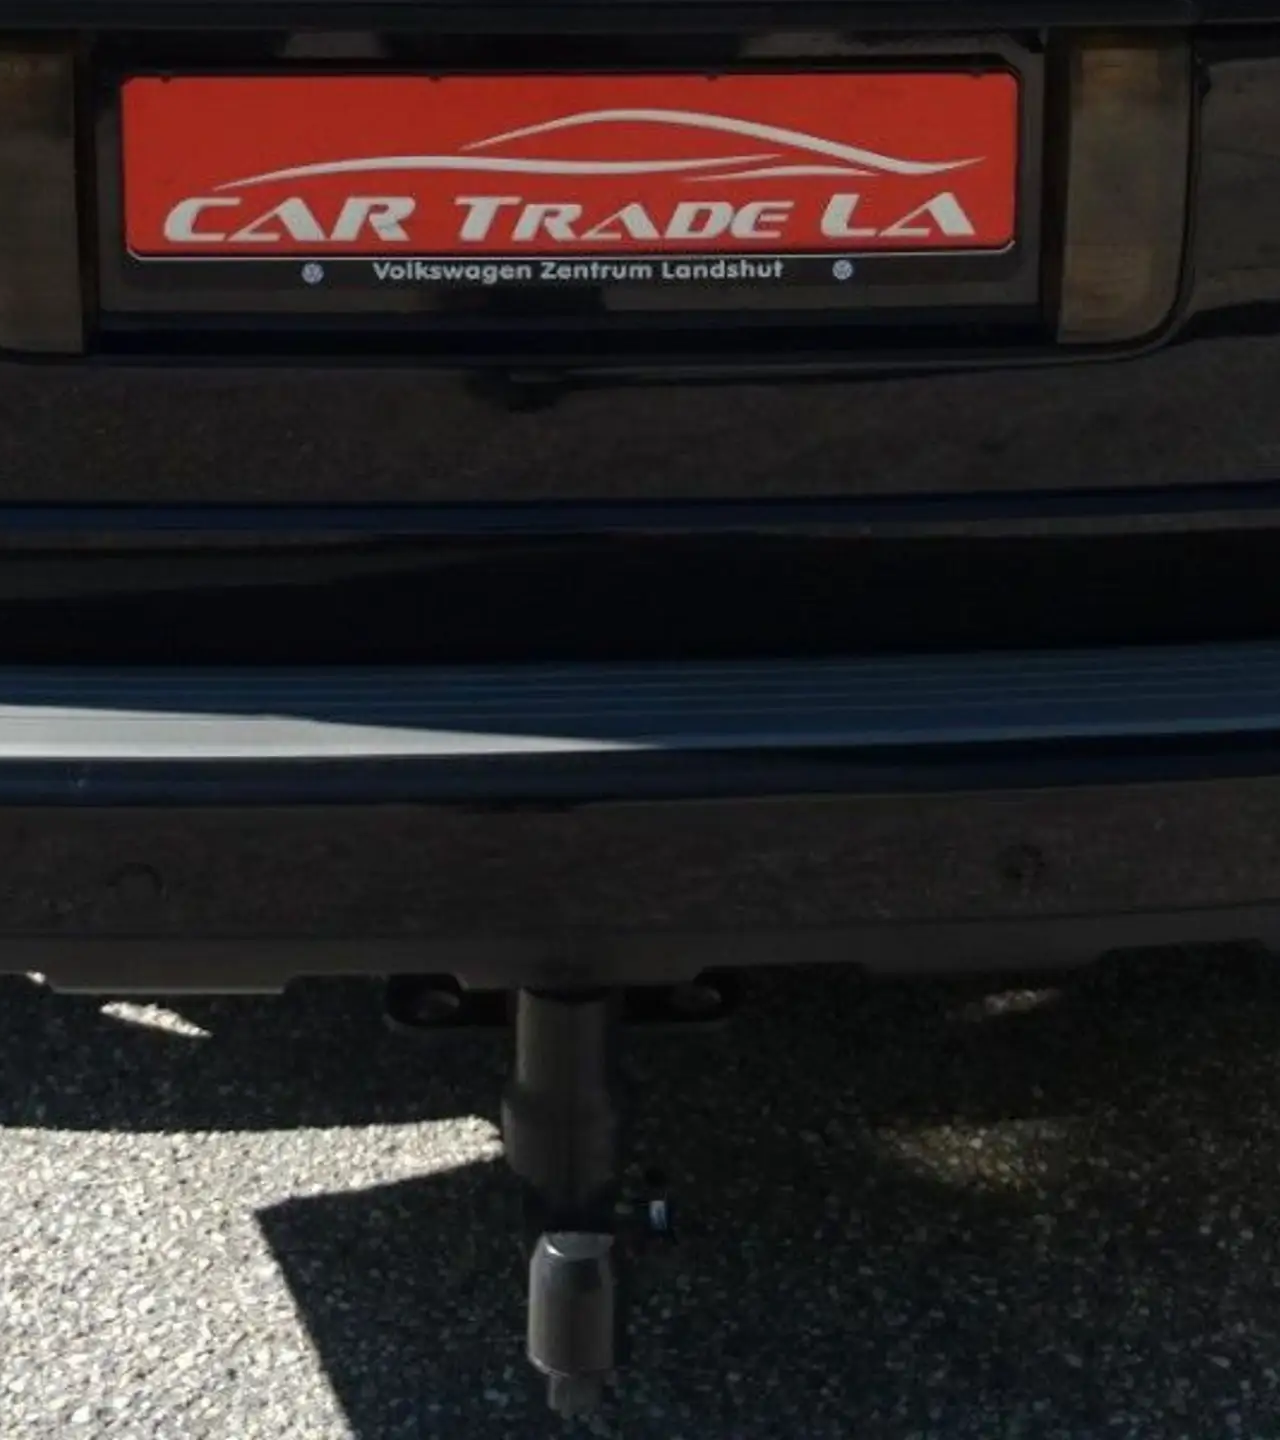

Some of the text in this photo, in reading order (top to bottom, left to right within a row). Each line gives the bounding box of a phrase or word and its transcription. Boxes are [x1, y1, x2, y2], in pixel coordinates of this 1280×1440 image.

[162, 196, 415, 243] CAR
[819, 191, 977, 239] LA
[373, 259, 784, 284] Volkswagen Zentrum Landshut
